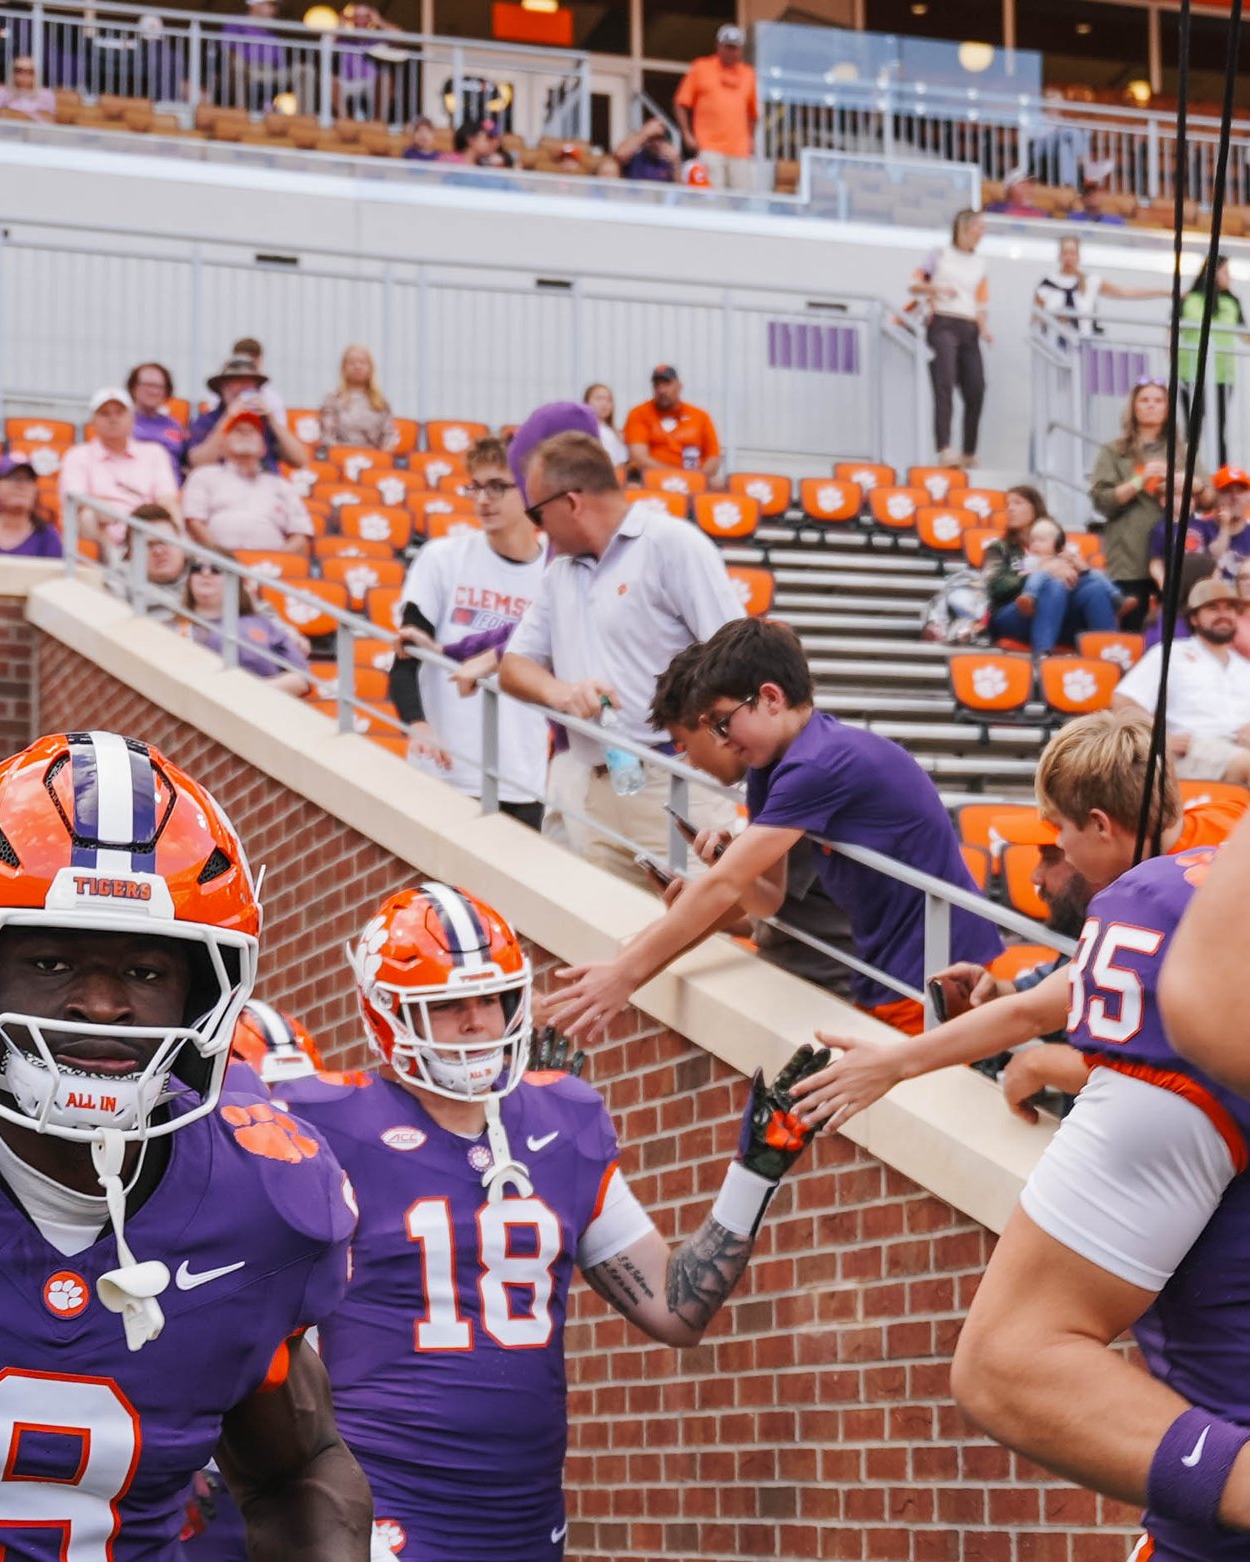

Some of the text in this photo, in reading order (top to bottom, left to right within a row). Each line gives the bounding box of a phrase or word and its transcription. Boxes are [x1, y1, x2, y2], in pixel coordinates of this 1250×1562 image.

[453, 585, 532, 618] CLEMS
[72, 876, 152, 901] TIGERS
[65, 1092, 117, 1113] ALL IN
[404, 1196, 564, 1352] 18
